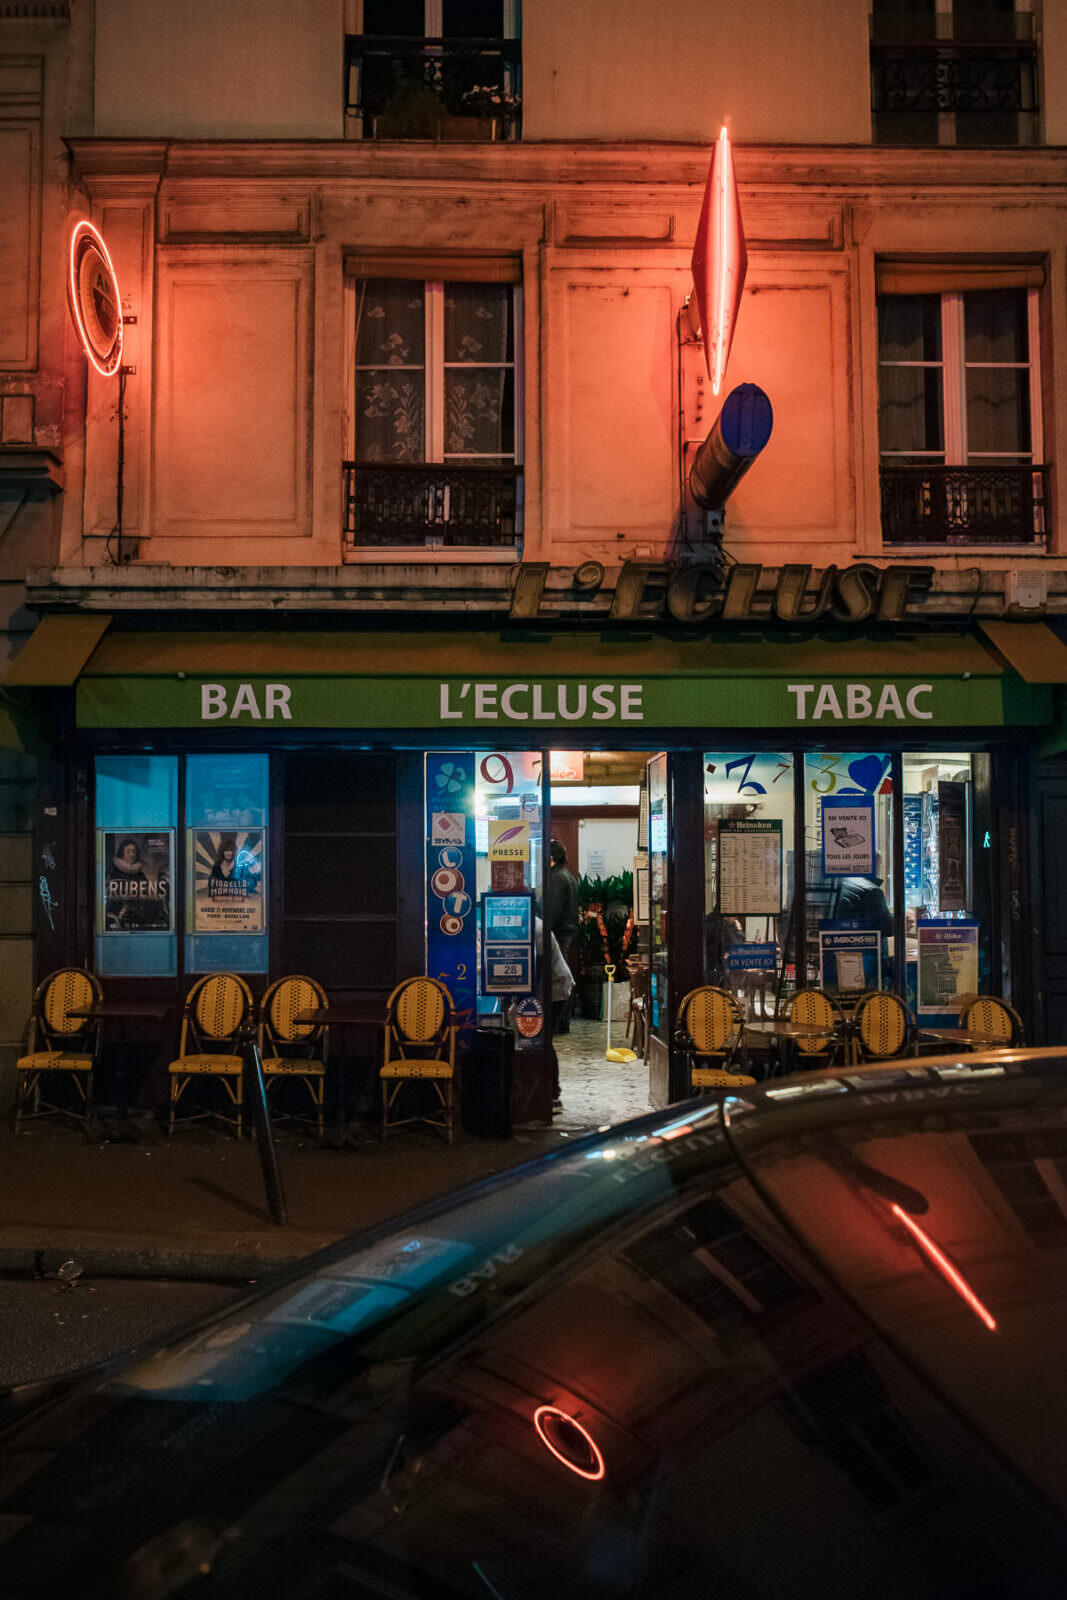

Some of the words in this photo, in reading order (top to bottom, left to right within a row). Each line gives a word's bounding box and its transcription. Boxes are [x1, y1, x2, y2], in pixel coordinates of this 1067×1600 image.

[200, 684, 293, 720] BAR
[439, 684, 644, 721] L'ECLUSE
[787, 684, 933, 720] TABAC
[772, 763, 792, 783] 7
[811, 754, 841, 793] 3
[109, 880, 167, 898] RUBENS
[455, 963, 467, 981] 2
[503, 965, 518, 975] 28
